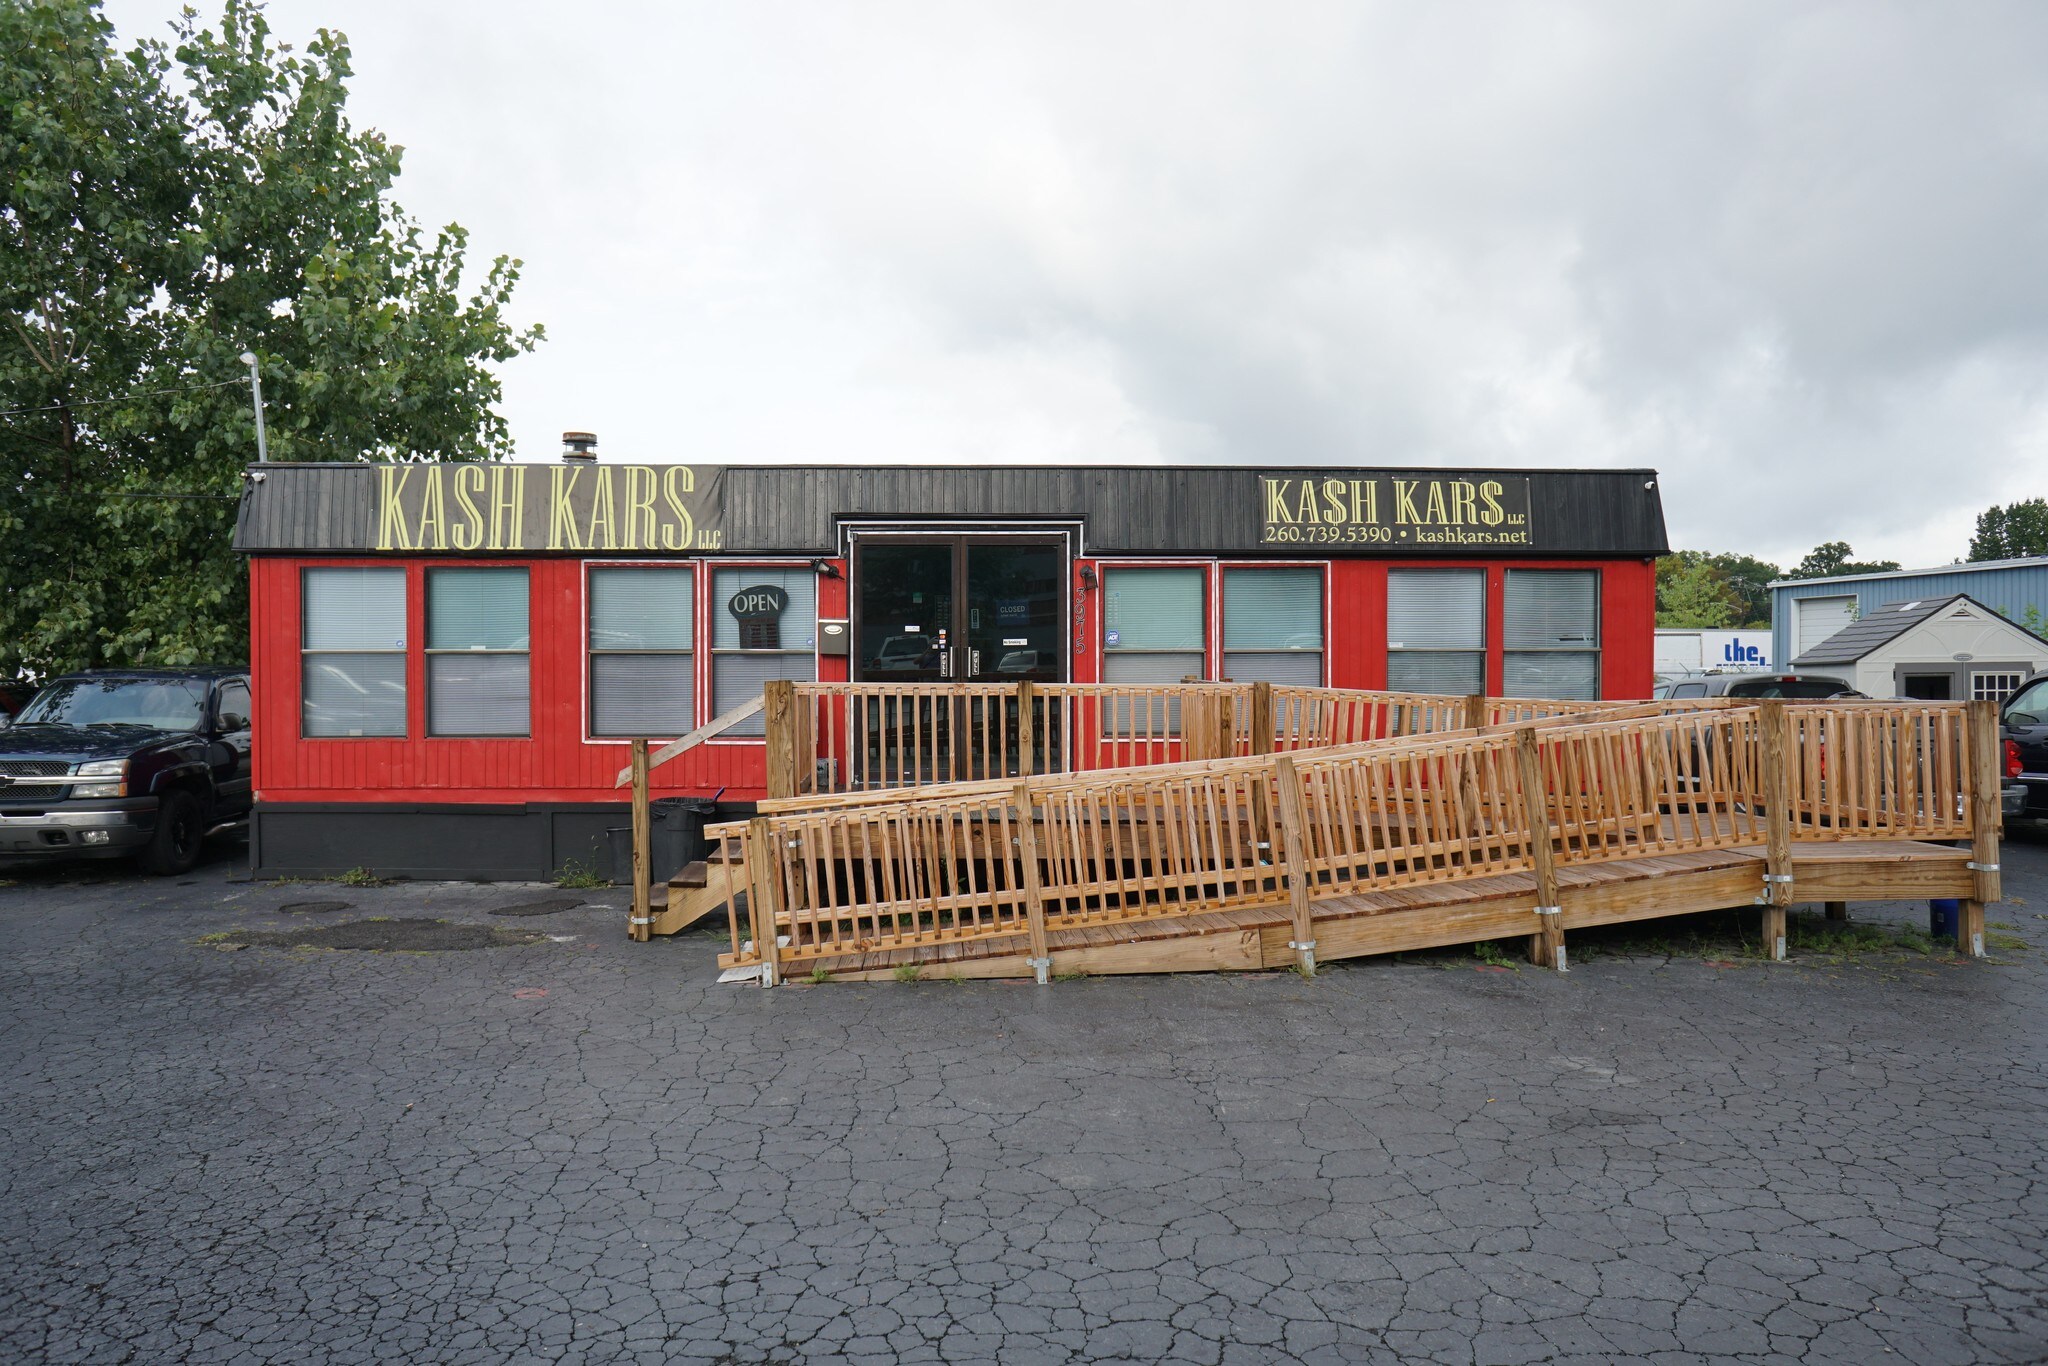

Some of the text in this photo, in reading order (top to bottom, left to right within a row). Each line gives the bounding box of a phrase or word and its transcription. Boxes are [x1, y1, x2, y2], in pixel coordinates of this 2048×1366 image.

[376, 465, 721, 550] KASH KARS LLC
[1507, 513, 1525, 525] LLC
[1266, 526, 1527, 543] 260.739.5390 kashkars.net
[733, 593, 779, 612] OPEN
[1000, 605, 1026, 613] CLOSED
